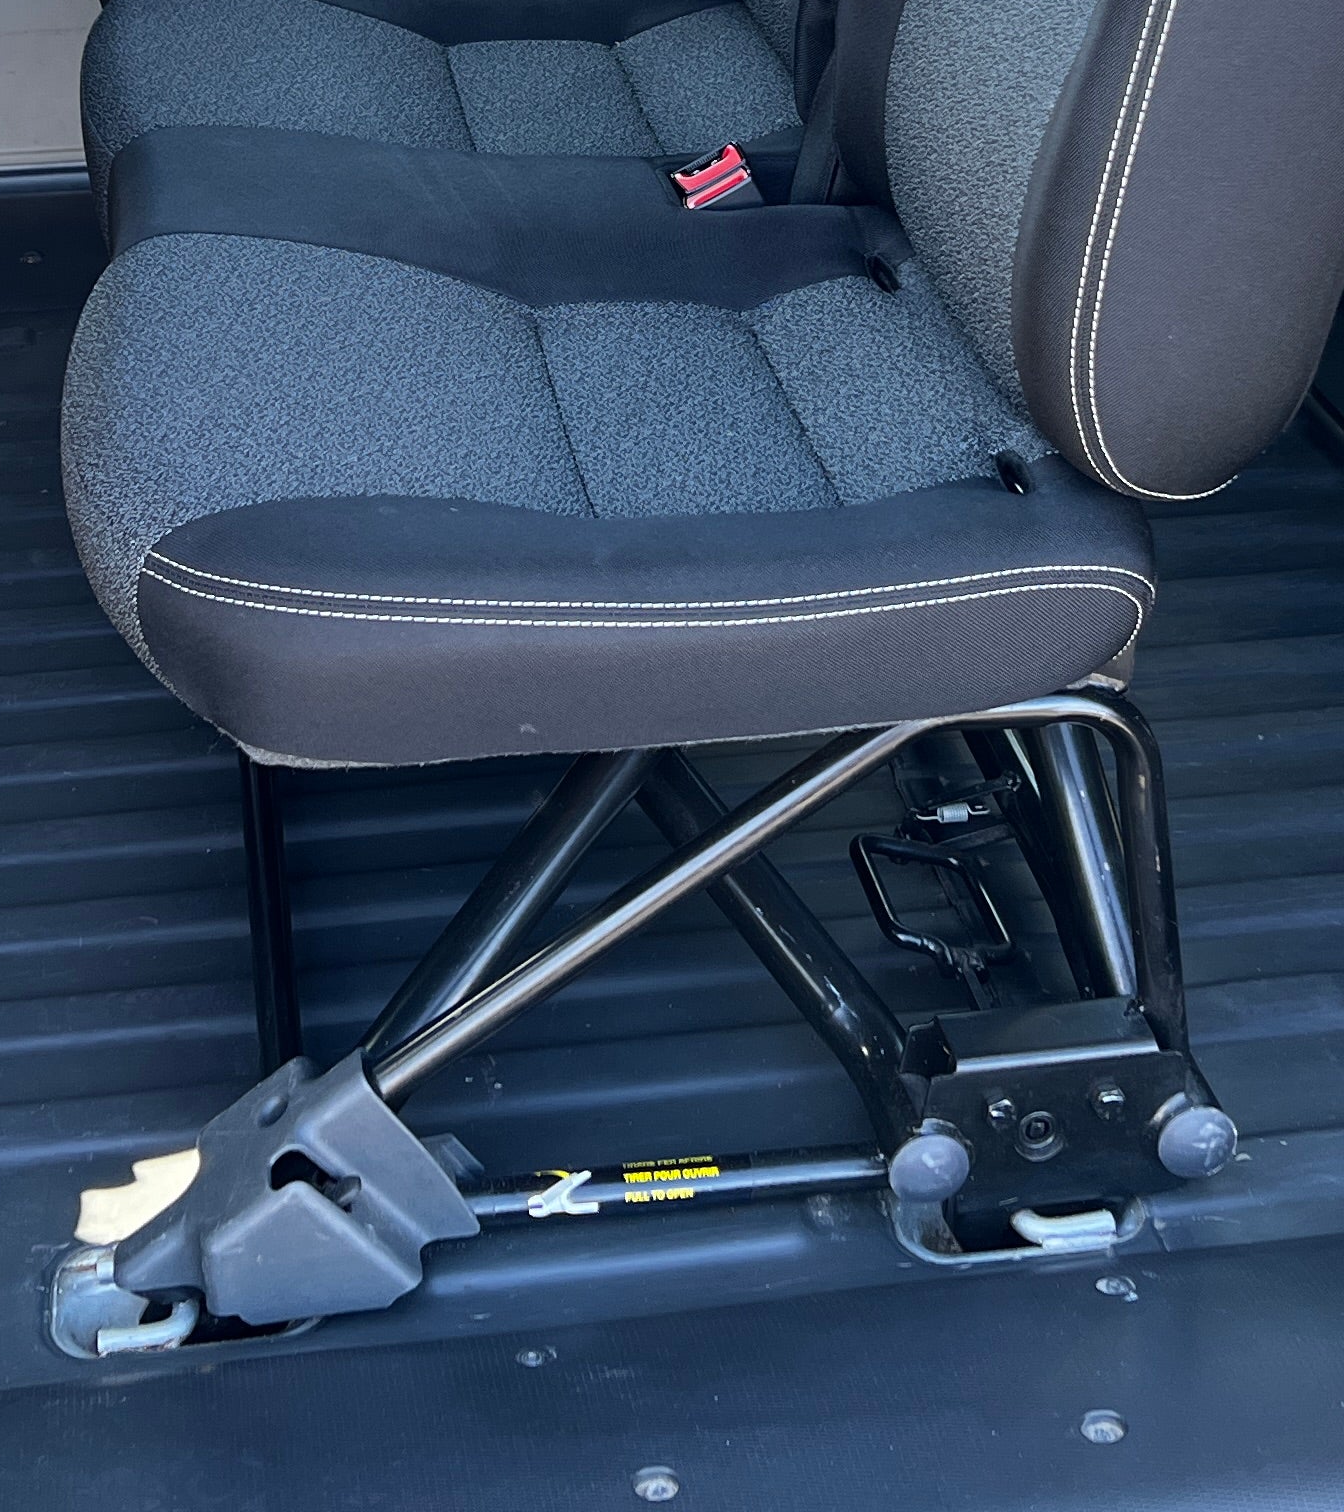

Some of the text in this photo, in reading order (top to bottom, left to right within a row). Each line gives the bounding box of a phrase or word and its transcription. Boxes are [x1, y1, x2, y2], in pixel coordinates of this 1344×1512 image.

[623, 1166, 720, 1184] TIRER POUR OUVRIR
[624, 1187, 694, 1203] PULL TO OPEN
